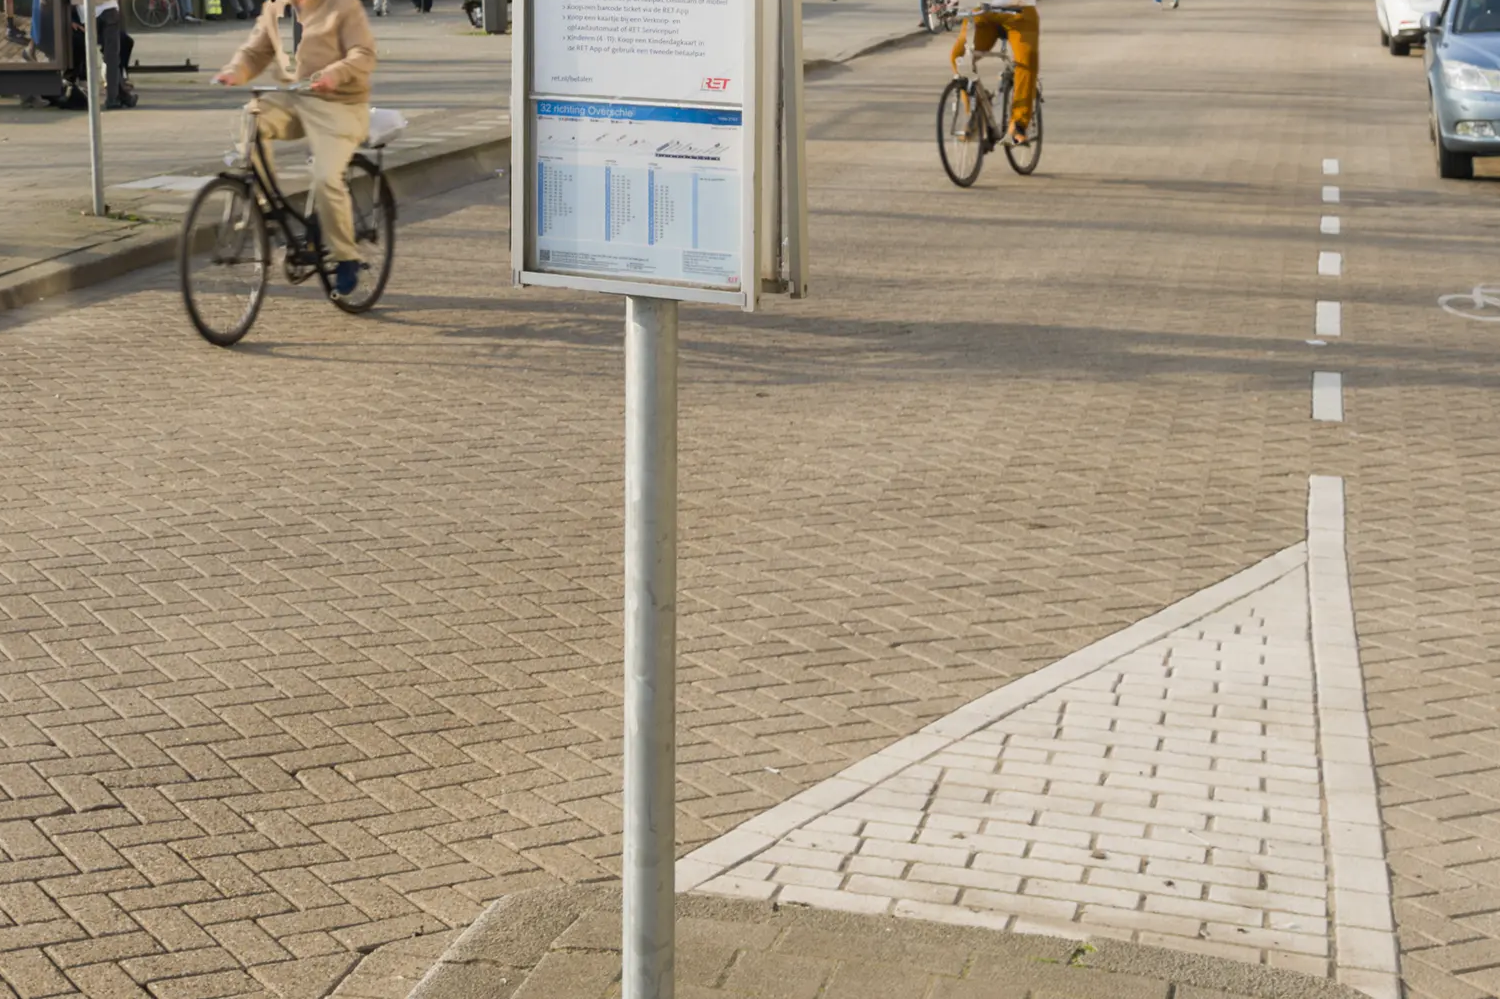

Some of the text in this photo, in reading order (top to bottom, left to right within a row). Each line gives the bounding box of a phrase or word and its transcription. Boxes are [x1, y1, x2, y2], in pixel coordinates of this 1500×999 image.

[567, 4, 584, 12] Koop
[597, 4, 622, 12] barcode
[567, 14, 583, 22] Koop
[597, 14, 619, 23] kaartje
[620, 15, 629, 24] bij
[642, 26, 679, 36] Servicepunt
[617, 36, 634, 45] Koop
[648, 37, 697, 47] Kinderdagkaart
[589, 45, 602, 53] App
[611, 46, 635, 54] gebruik
[551, 75, 593, 83] ret.nl/betalen
[705, 77, 731, 89] RET
[540, 103, 633, 118] 32 richting Overschie
